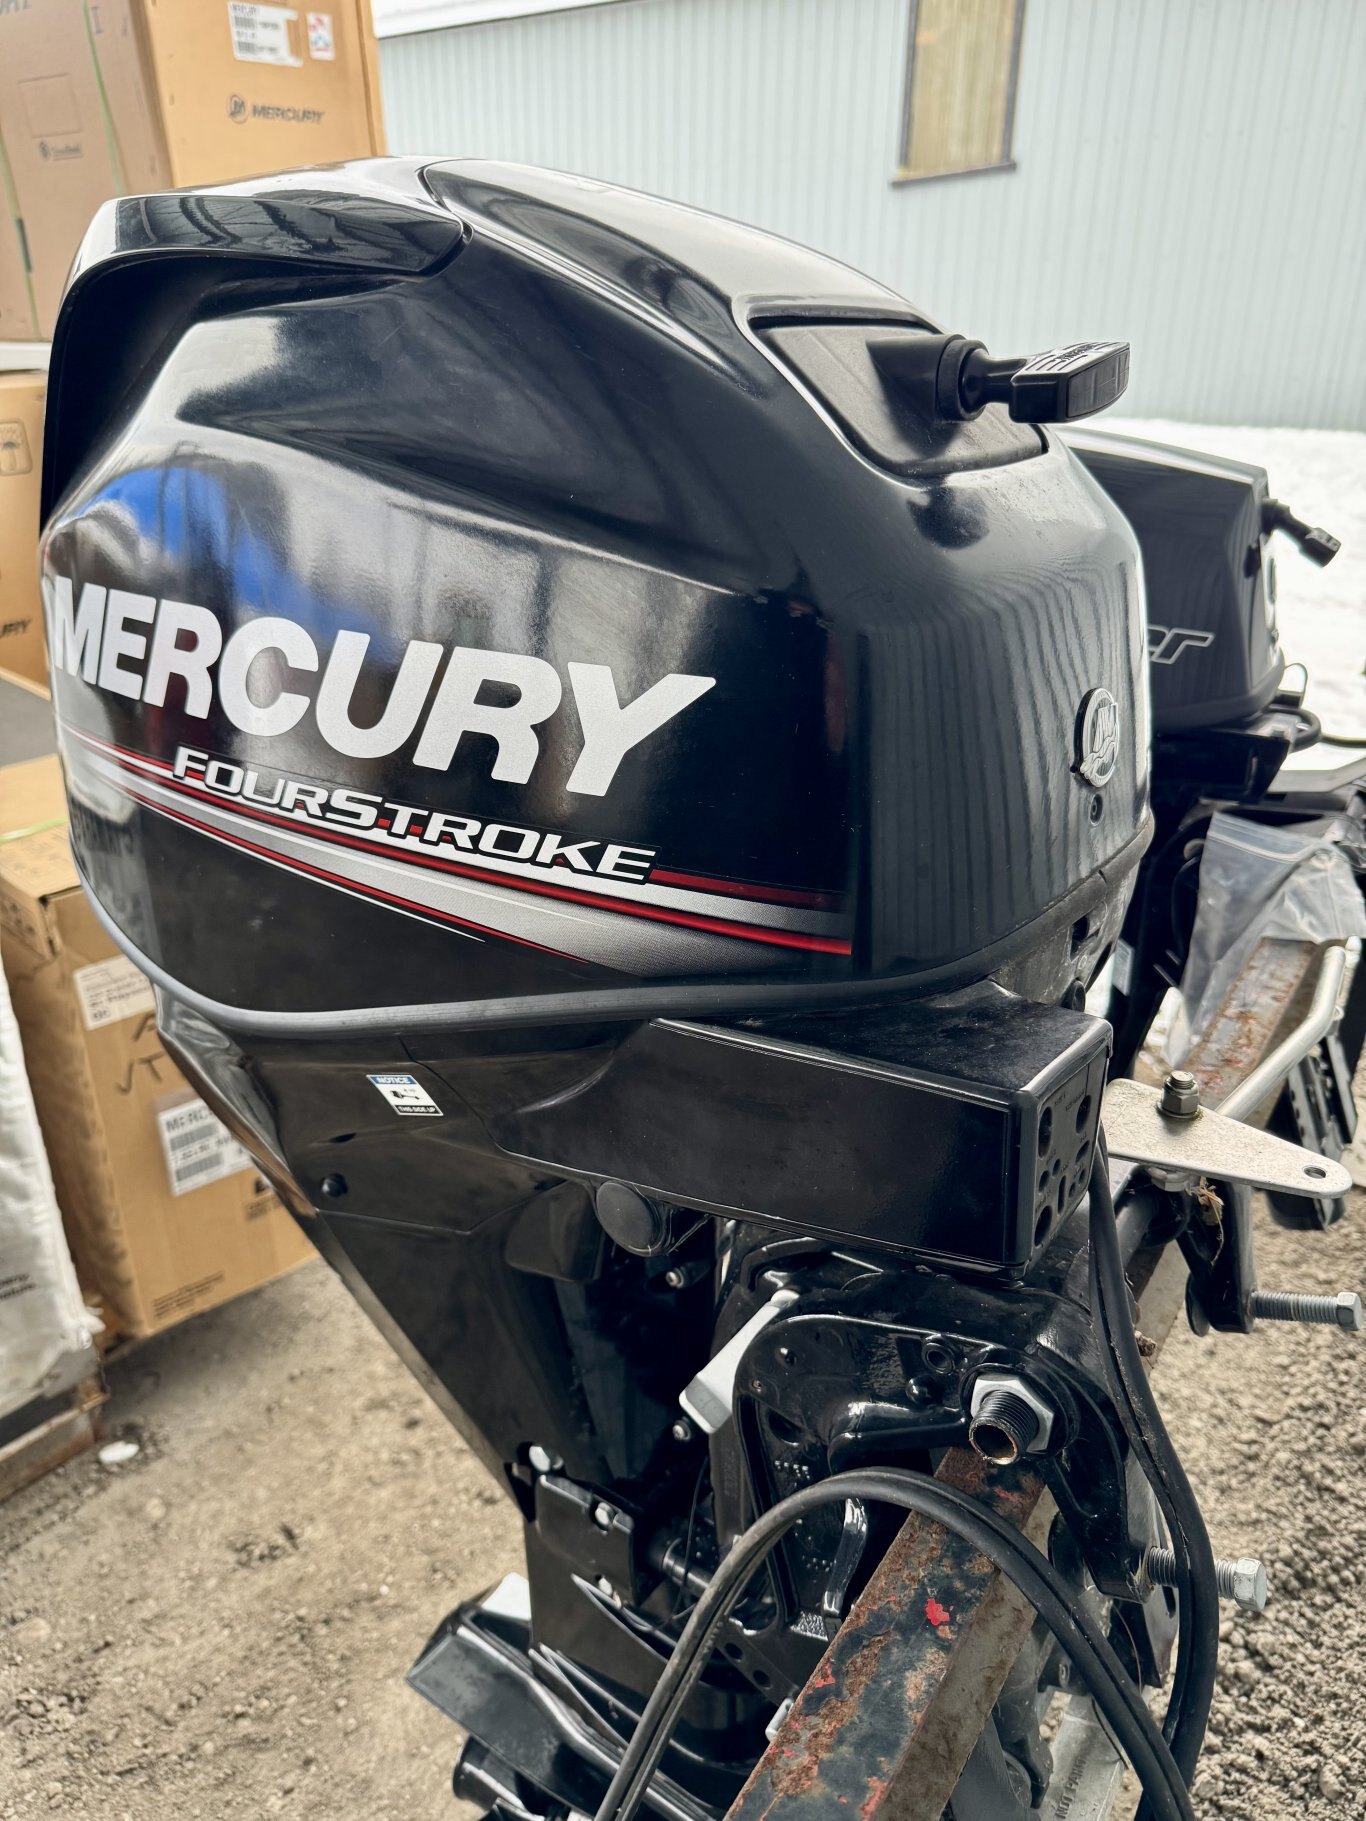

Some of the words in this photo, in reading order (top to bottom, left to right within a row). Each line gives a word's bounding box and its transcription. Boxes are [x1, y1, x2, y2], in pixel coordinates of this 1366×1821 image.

[252, 104, 325, 124] MERCURY
[52, 575, 717, 797] MERCURY
[376, 1076, 411, 1084] NOTICE
